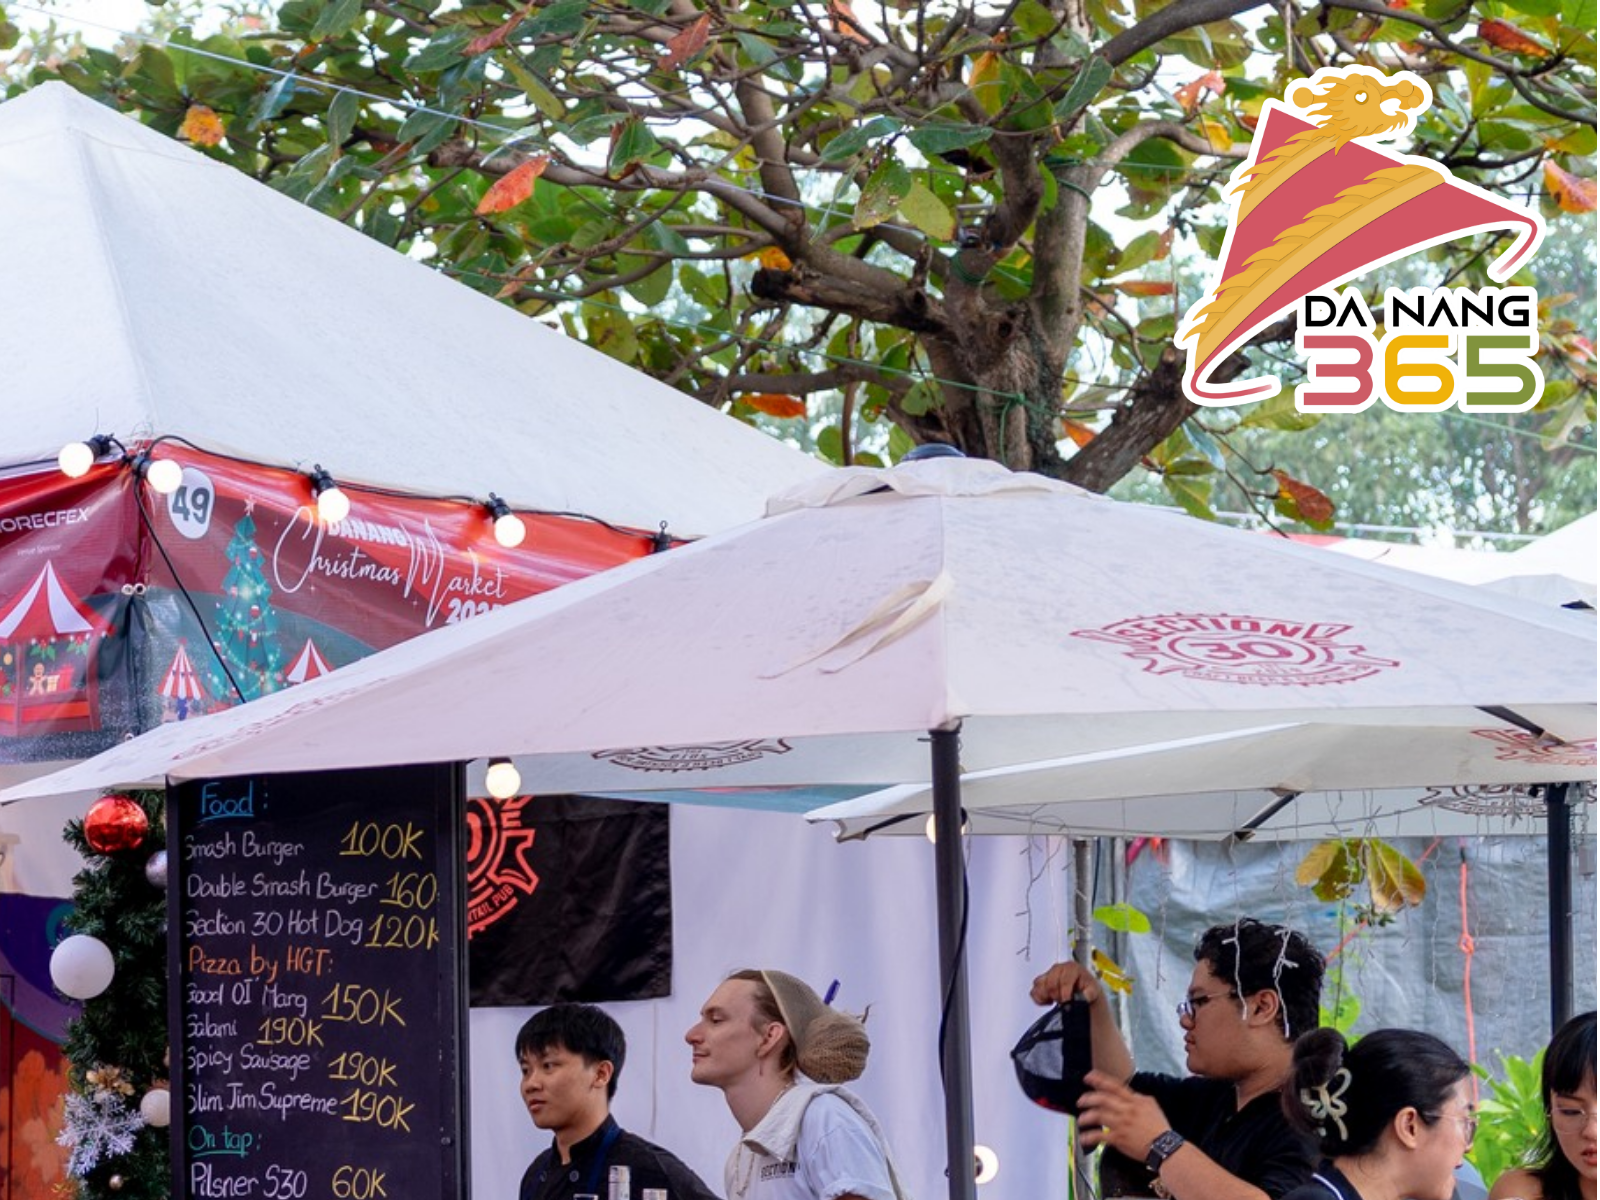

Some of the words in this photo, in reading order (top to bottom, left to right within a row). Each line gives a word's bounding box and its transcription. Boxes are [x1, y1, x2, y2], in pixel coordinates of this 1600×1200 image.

[172, 485, 210, 524] 49
[273, 506, 402, 593] Christmas
[399, 517, 510, 627] Market
[1188, 641, 1293, 660] 30
[243, 831, 304, 866] Burger
[188, 873, 246, 897] Double
[252, 869, 310, 897] Smash
[317, 872, 378, 904] Burger
[492, 884, 514, 906] PUB
[252, 911, 283, 936] 30
[289, 908, 319, 934] Hot
[325, 909, 363, 945] Dog
[188, 945, 241, 975] Pizza
[250, 944, 278, 983] by
[262, 985, 307, 1018] Marg
[241, 1043, 310, 1081] Sausage
[227, 1083, 257, 1110] Jim
[259, 1082, 338, 1121] Supreme
[189, 1125, 215, 1150] On
[191, 1162, 259, 1198] Pilsner
